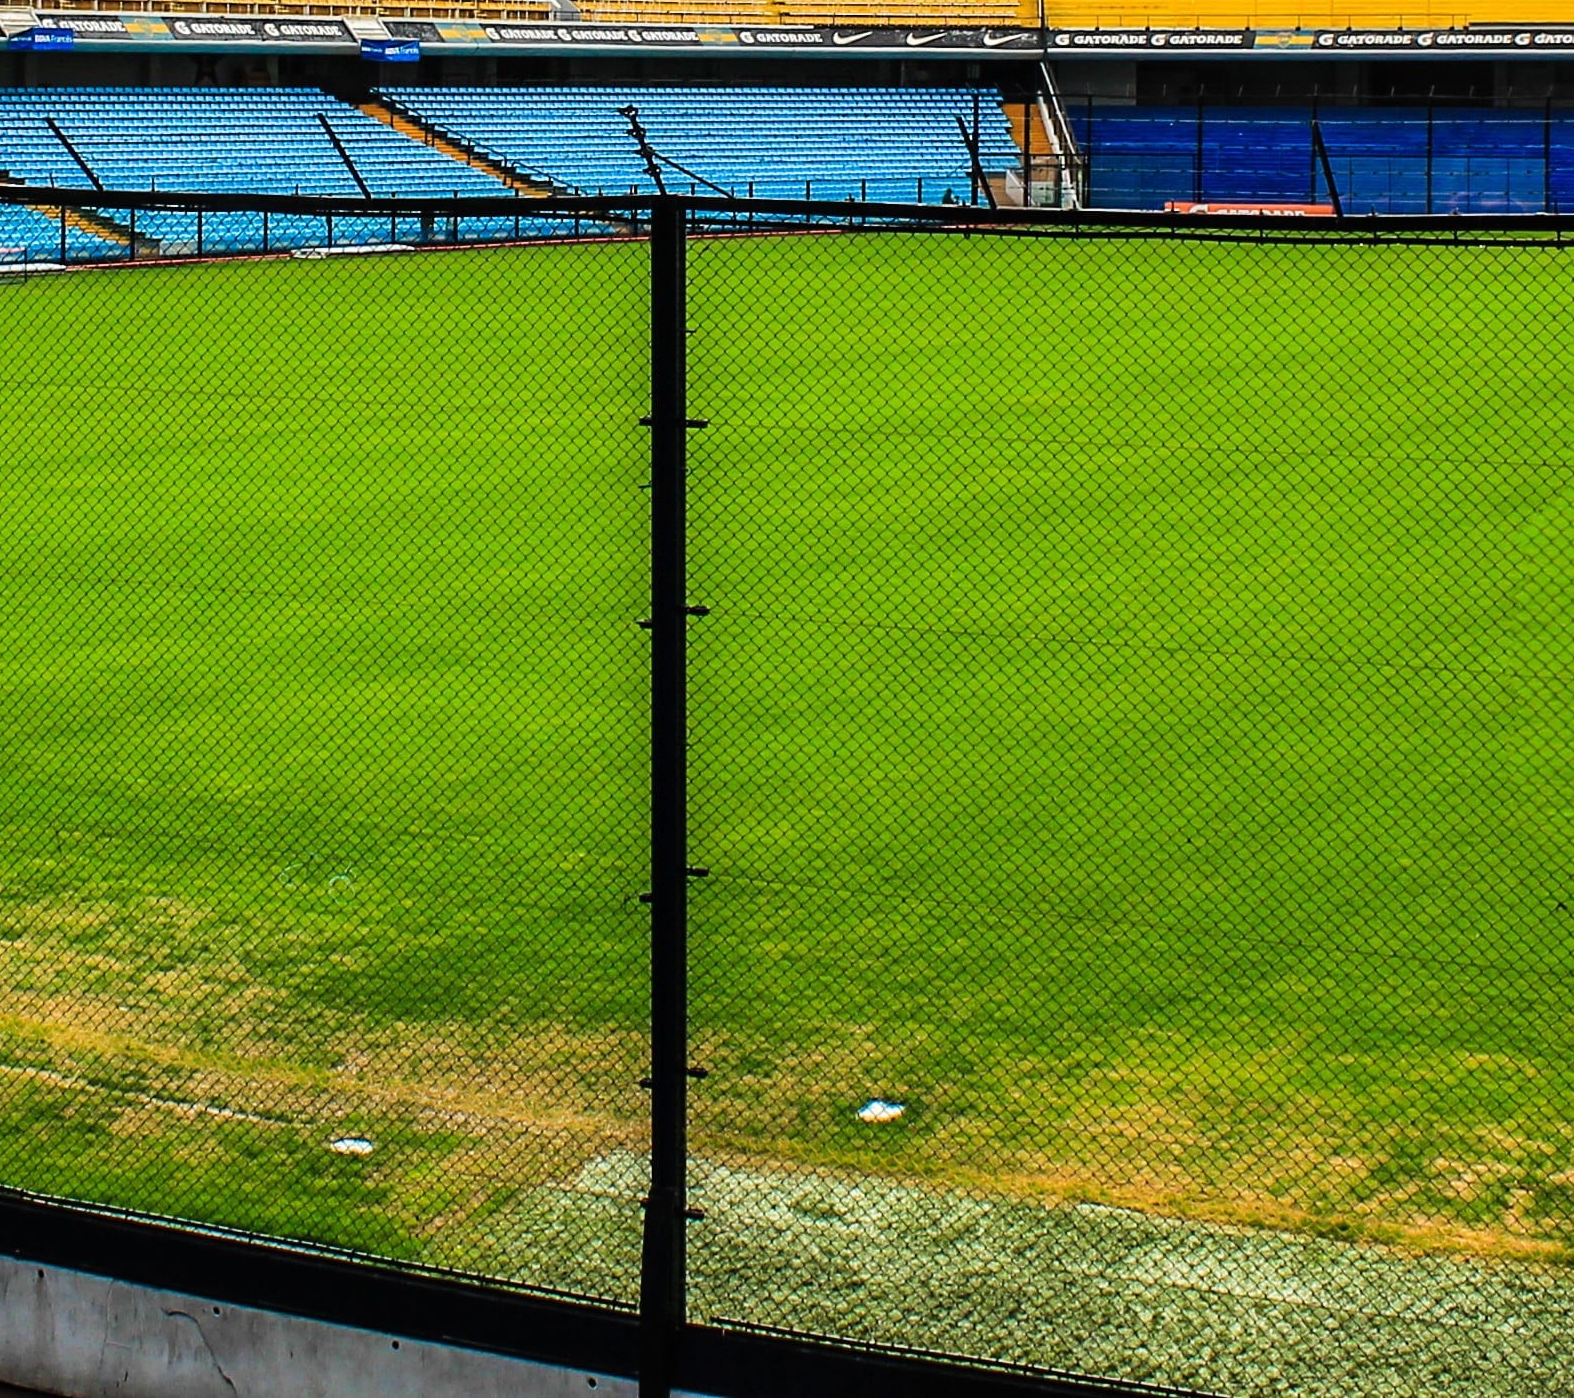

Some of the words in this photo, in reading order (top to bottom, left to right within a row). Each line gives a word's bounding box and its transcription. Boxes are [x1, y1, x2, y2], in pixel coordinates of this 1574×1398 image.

[191, 23, 256, 36] GATORADE
[281, 24, 341, 36] GATORADE
[499, 28, 557, 40] GATORADE
[572, 29, 628, 42] GATORADE
[642, 30, 698, 42] GATORADE
[756, 32, 823, 43] GATORADE
[1073, 34, 1147, 46] GATORADE
[1169, 34, 1243, 45] GATORADE
[1337, 34, 1412, 45] GATORADE
[1436, 33, 1511, 45] GATORADE
